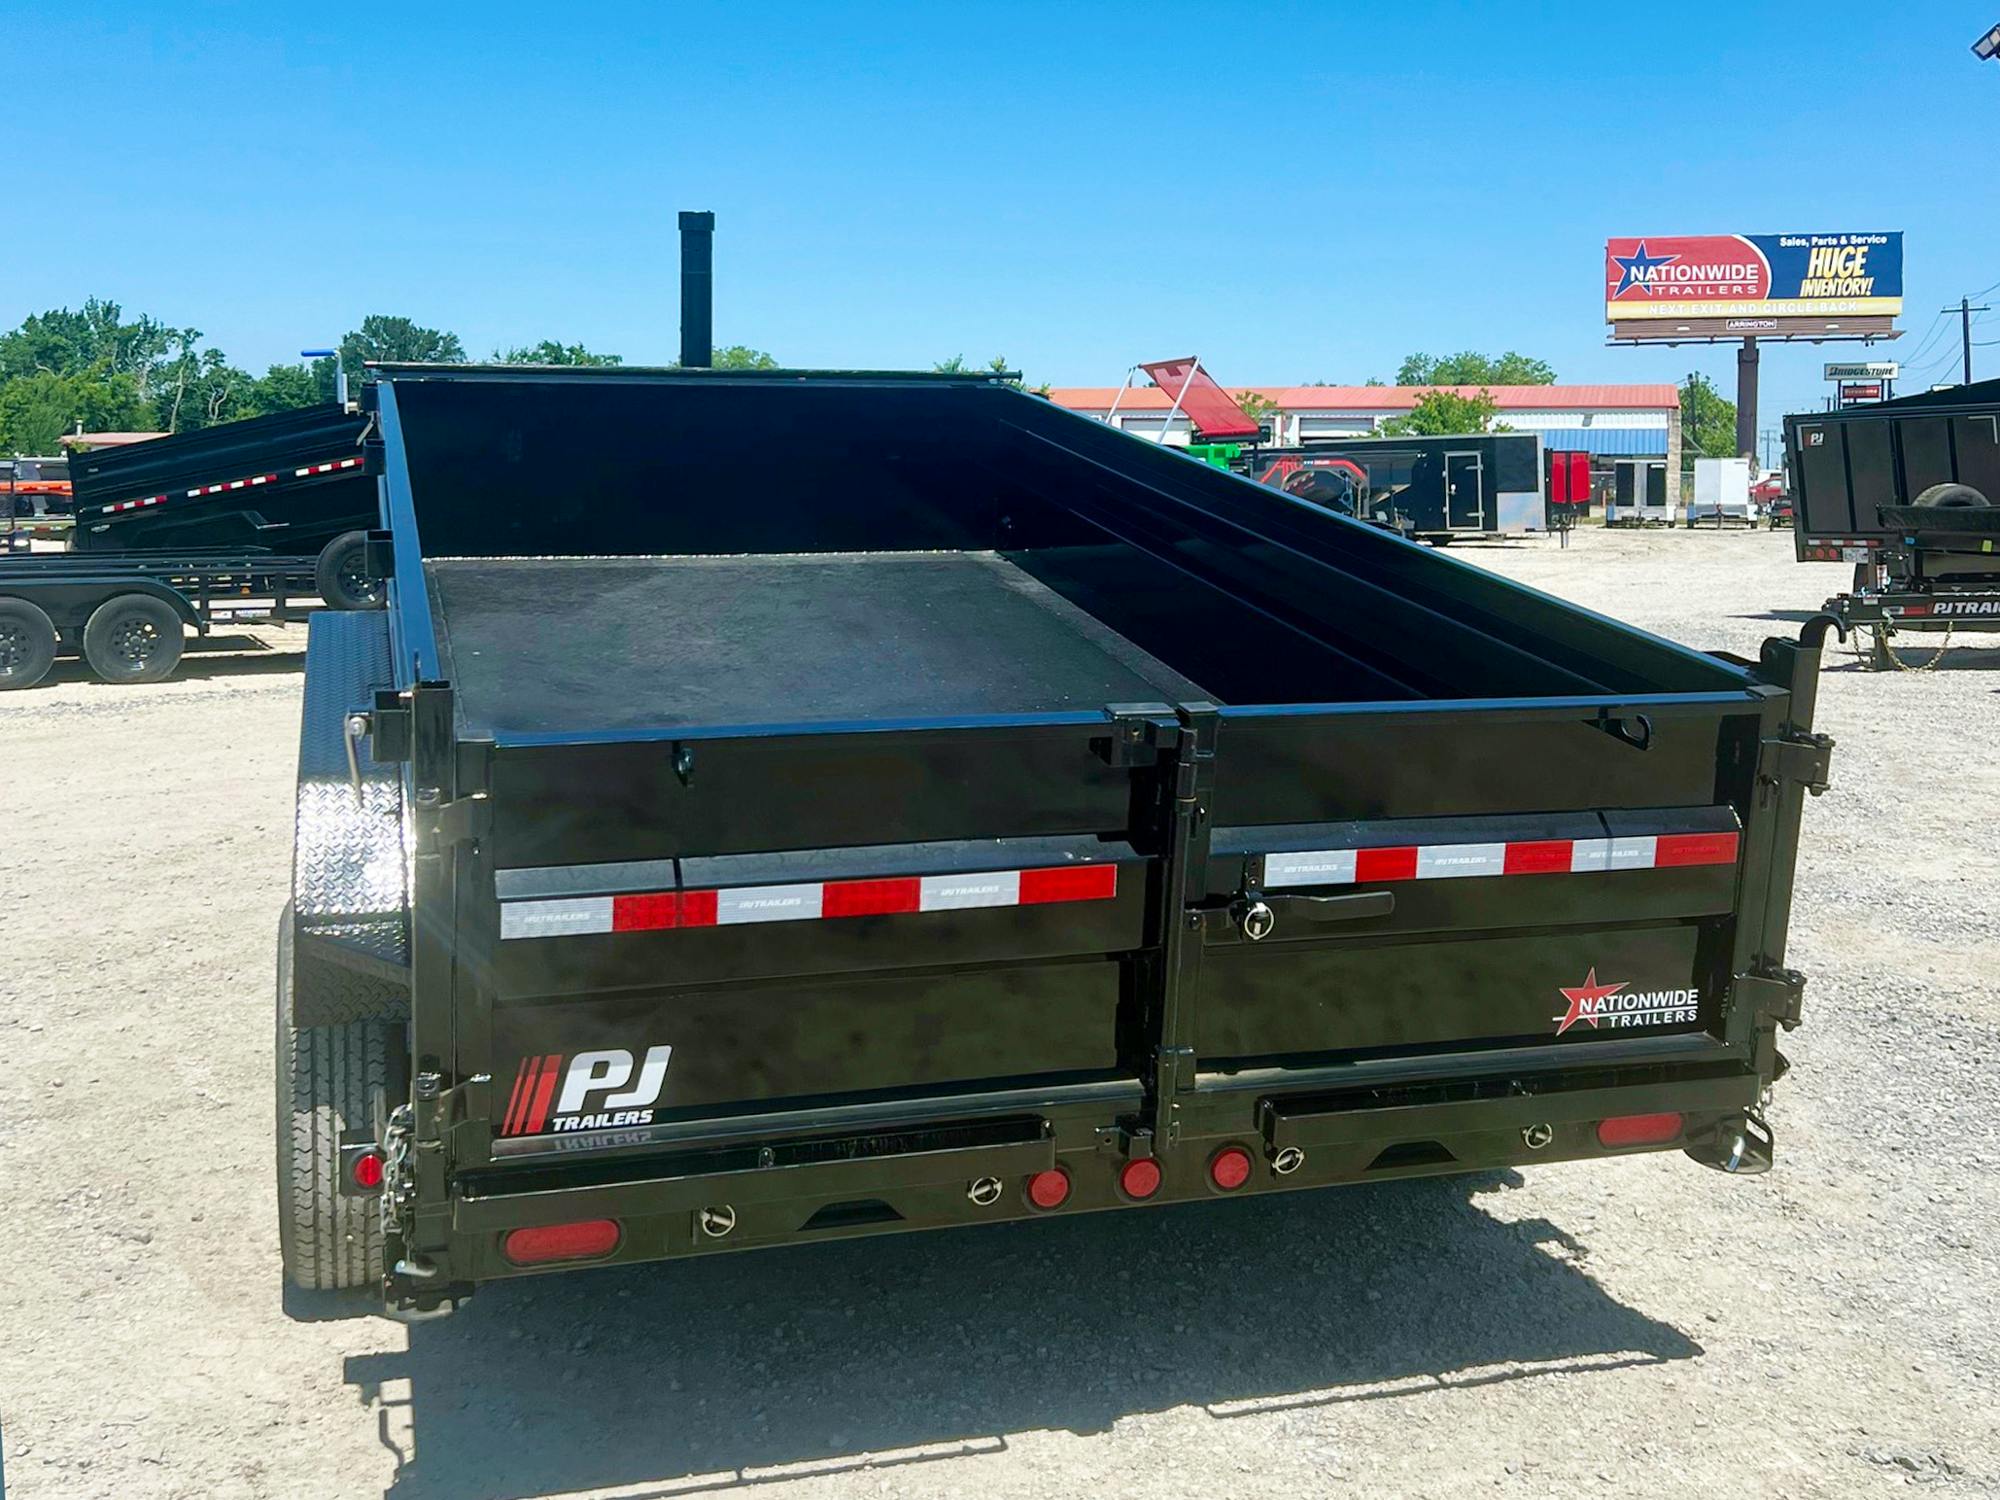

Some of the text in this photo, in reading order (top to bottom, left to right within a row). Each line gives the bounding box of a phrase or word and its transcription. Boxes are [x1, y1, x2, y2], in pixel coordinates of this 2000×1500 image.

[1780, 234, 1888, 248] Sales, Parts & Service
[1807, 245, 1869, 278] HUGE
[1630, 264, 1759, 281] NATIONWIDE
[1655, 285, 1758, 295] TRAILERS
[1800, 277, 1874, 297] INVENTORY!
[1648, 301, 1857, 314] NEXT EXIT AND CIRCLE BACK
[1728, 320, 1775, 329] ARRINGTON
[1829, 366, 1895, 376] BRIDGESTONE
[1579, 989, 1699, 1013] NATIONWIDE
[1609, 1009, 1697, 1028] TRAILERS
[557, 1045, 672, 1113] PJ
[552, 1109, 654, 1132] TRAILERS
